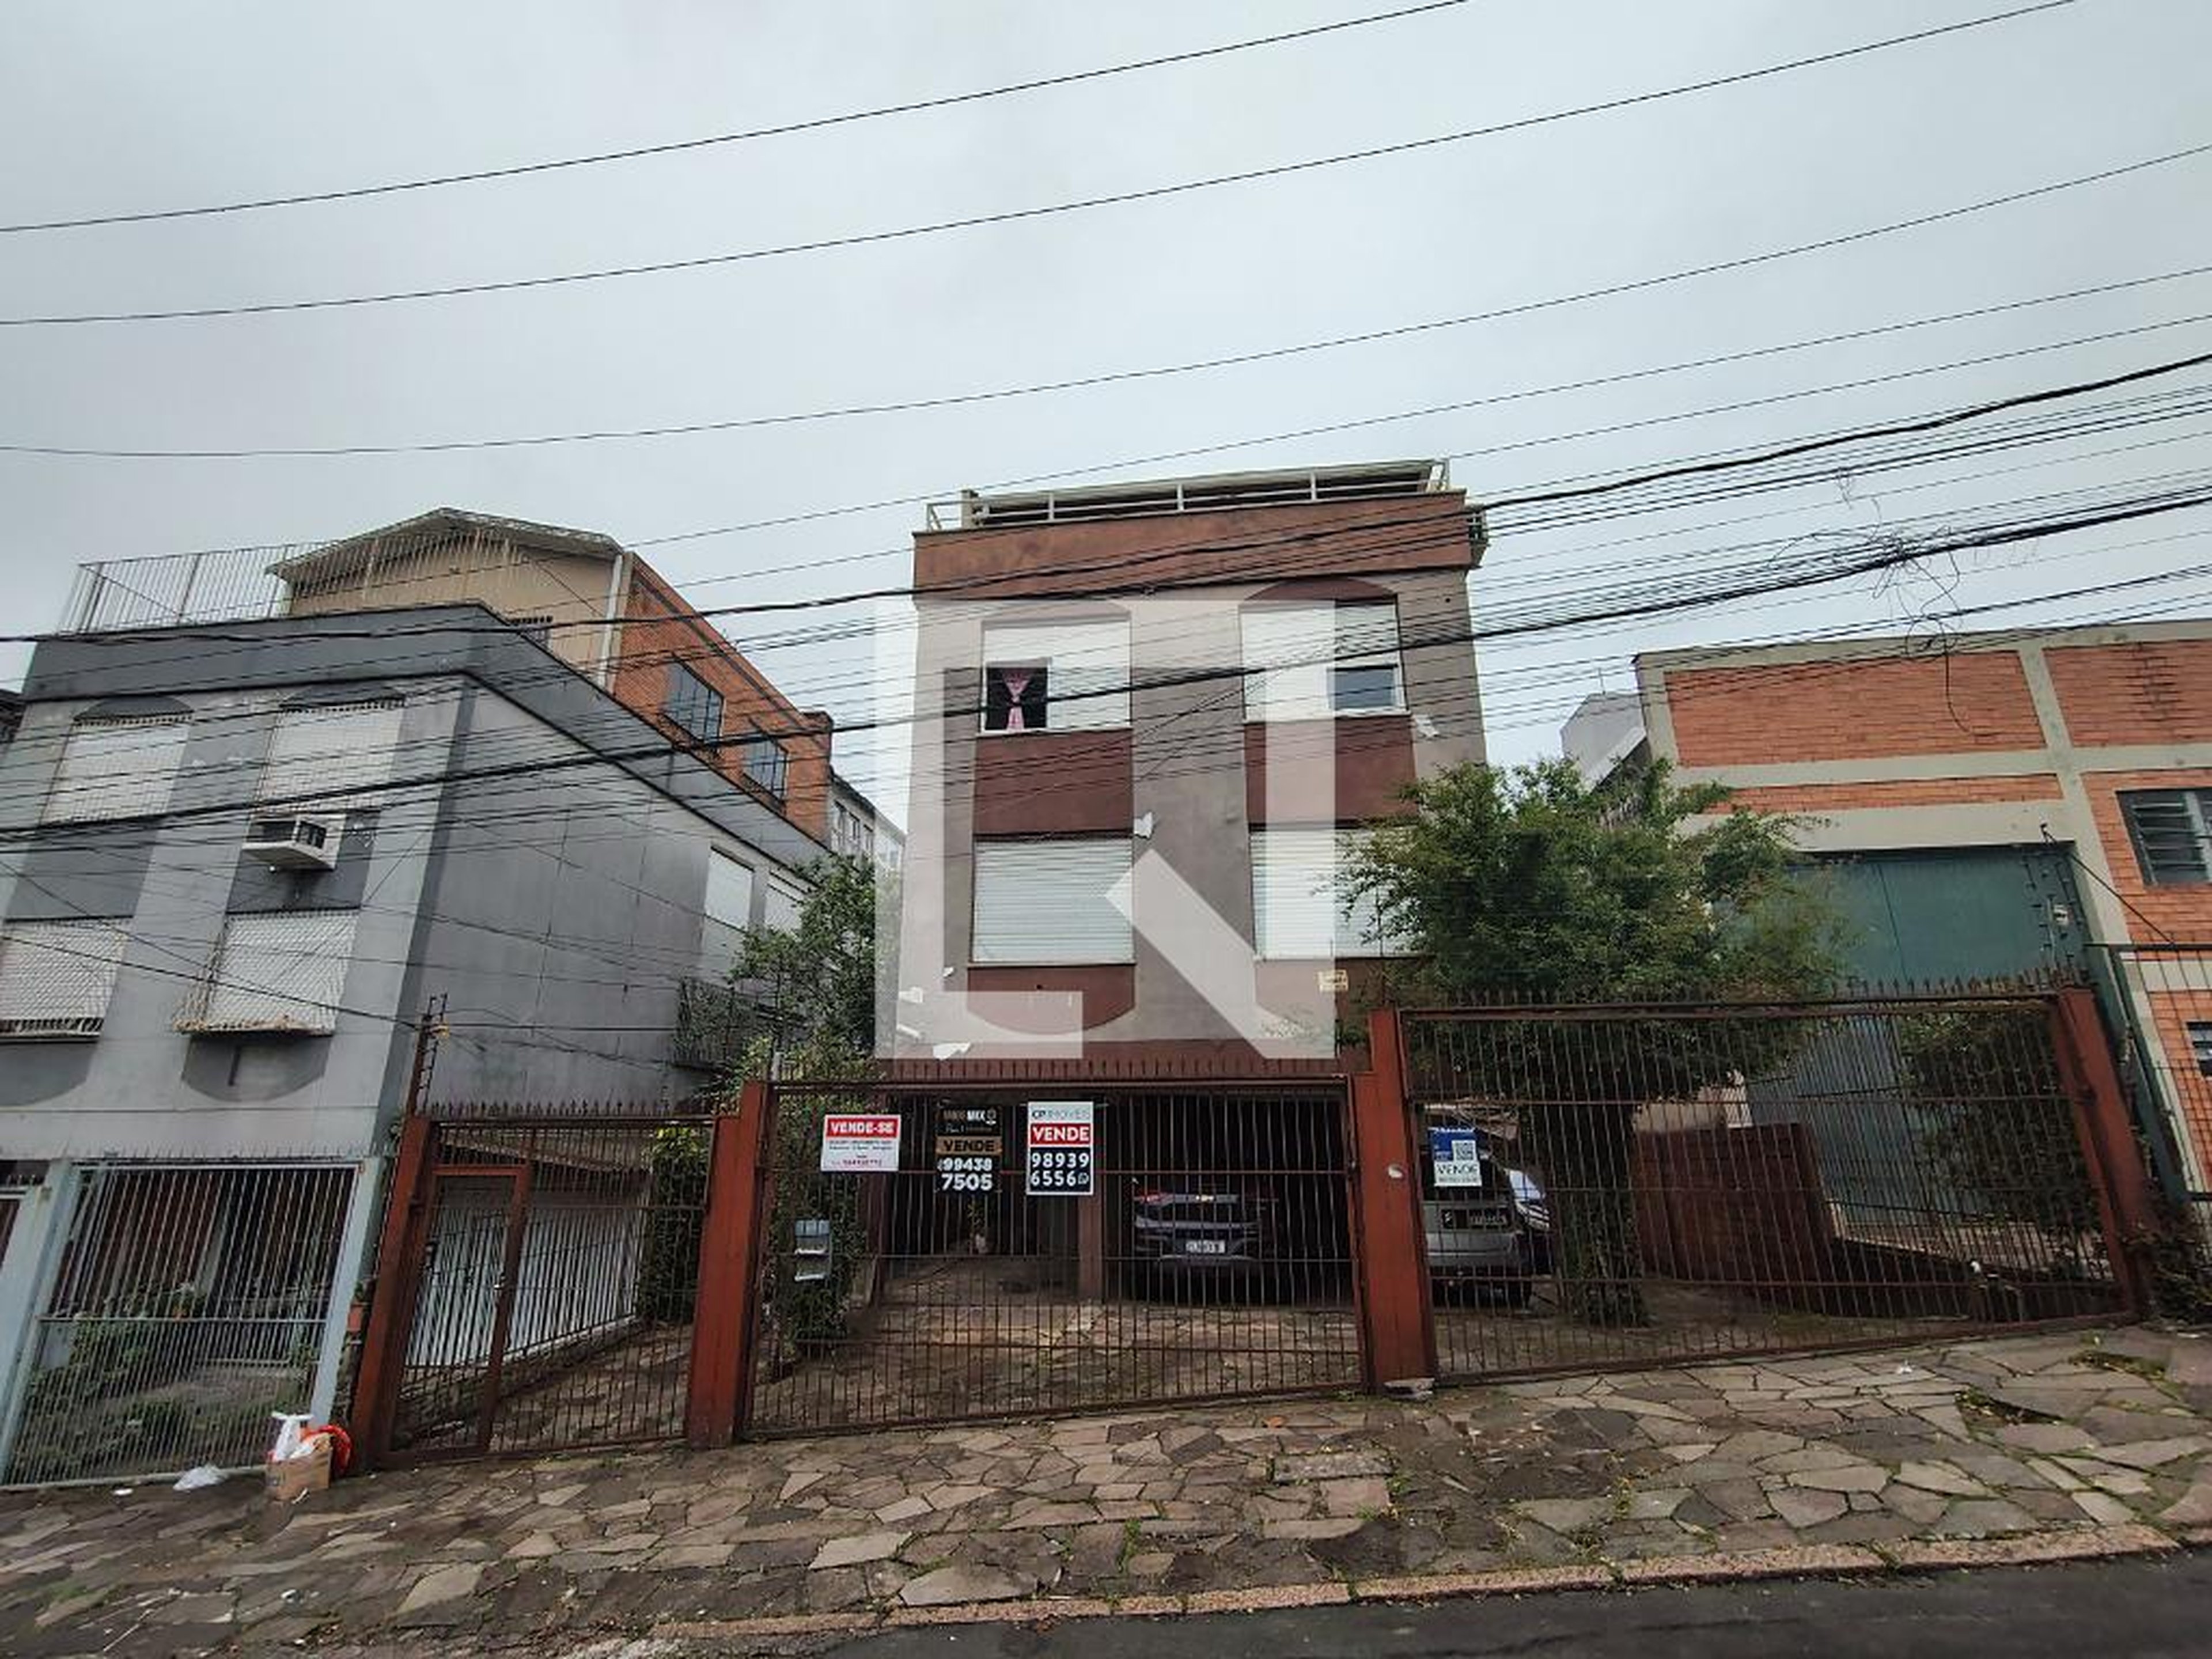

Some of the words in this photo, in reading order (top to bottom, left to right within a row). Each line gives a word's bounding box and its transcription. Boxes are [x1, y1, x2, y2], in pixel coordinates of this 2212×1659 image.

[830, 1120, 895, 1135] VENDE-SE
[1032, 1126, 1090, 1141] VENDE
[943, 1139, 995, 1152] VENDE
[1032, 1152, 1090, 1168] 98939
[941, 1173, 993, 1191] 7505
[1031, 1170, 1077, 1187] 6556
